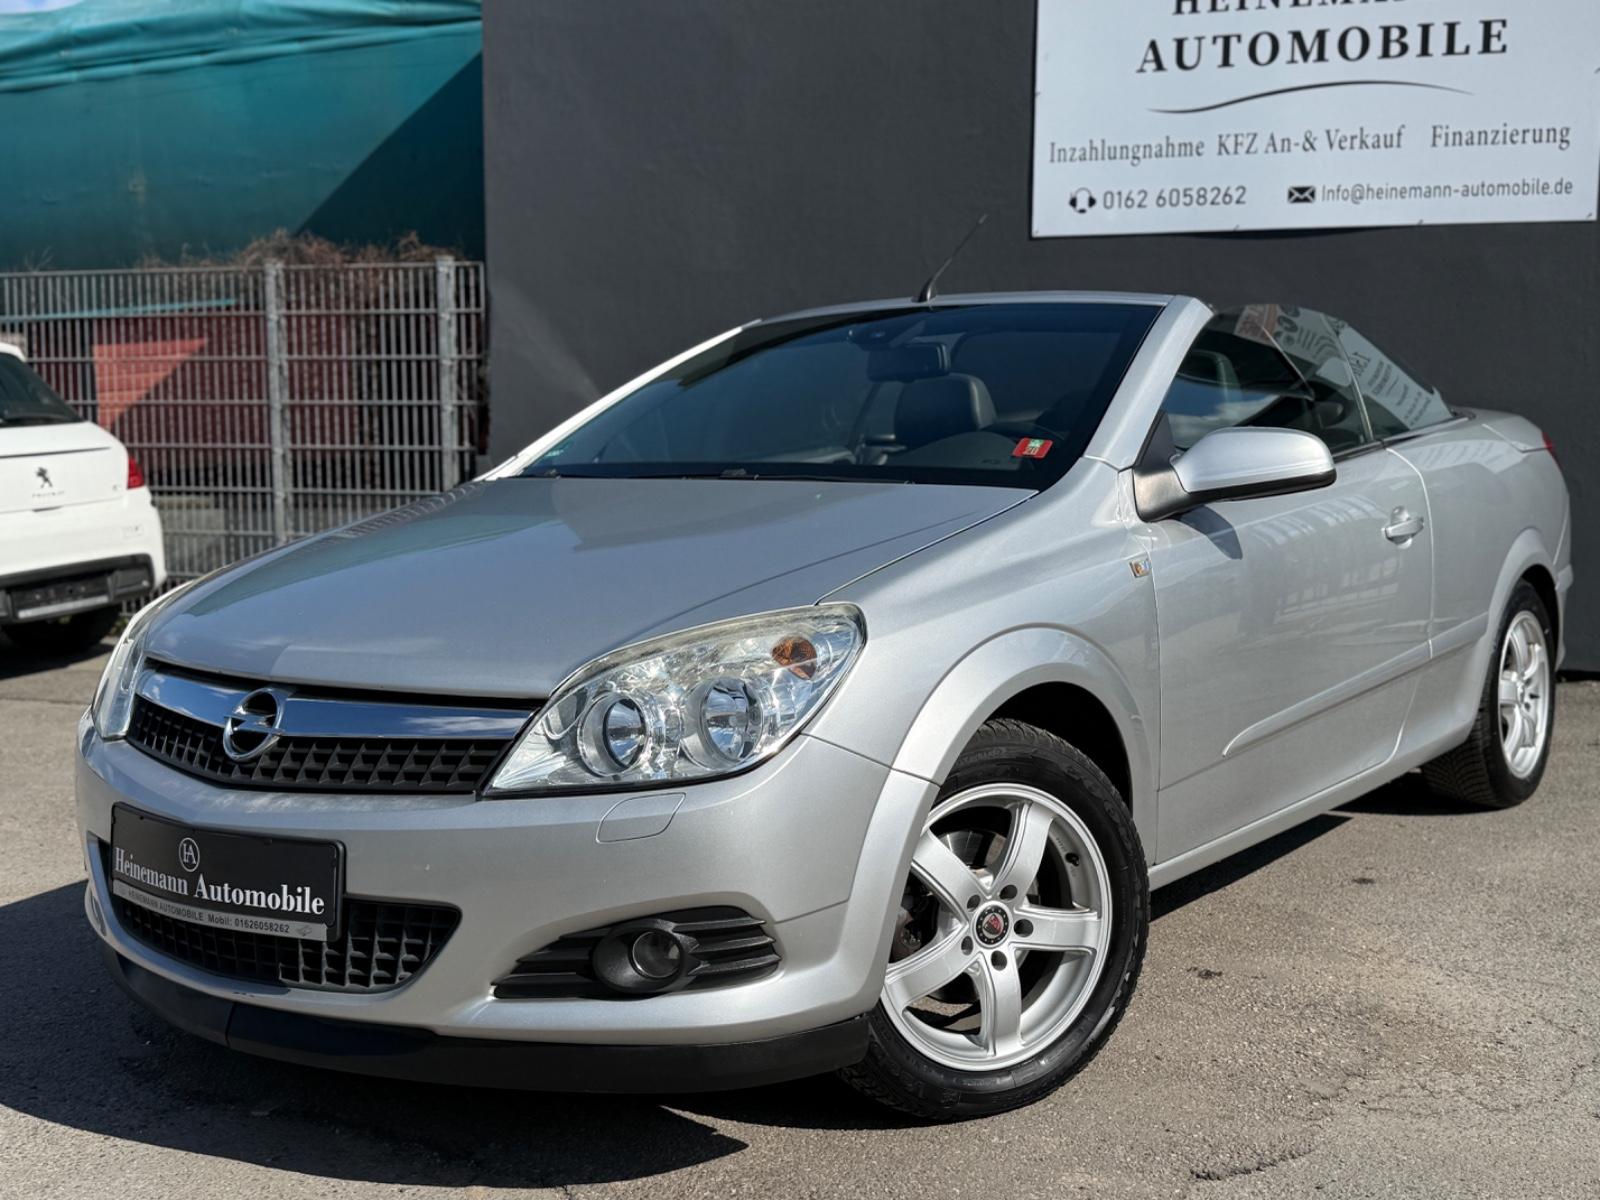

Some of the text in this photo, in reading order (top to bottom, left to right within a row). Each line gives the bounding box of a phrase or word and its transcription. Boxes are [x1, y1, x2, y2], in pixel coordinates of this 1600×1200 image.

[1136, 19, 1508, 73] AUTOMOBILE
[1049, 135, 1205, 167] Inzahlungnahme
[1217, 132, 1259, 157] KFZ
[1325, 124, 1406, 151] Verkauf
[1431, 122, 1571, 151] Finanzierung
[1103, 177, 1574, 210] 0162 6058262 Info@heinemann-automobile.de
[115, 846, 325, 915] Heinemann Automobile
[207, 913, 233, 927] Mobil:
